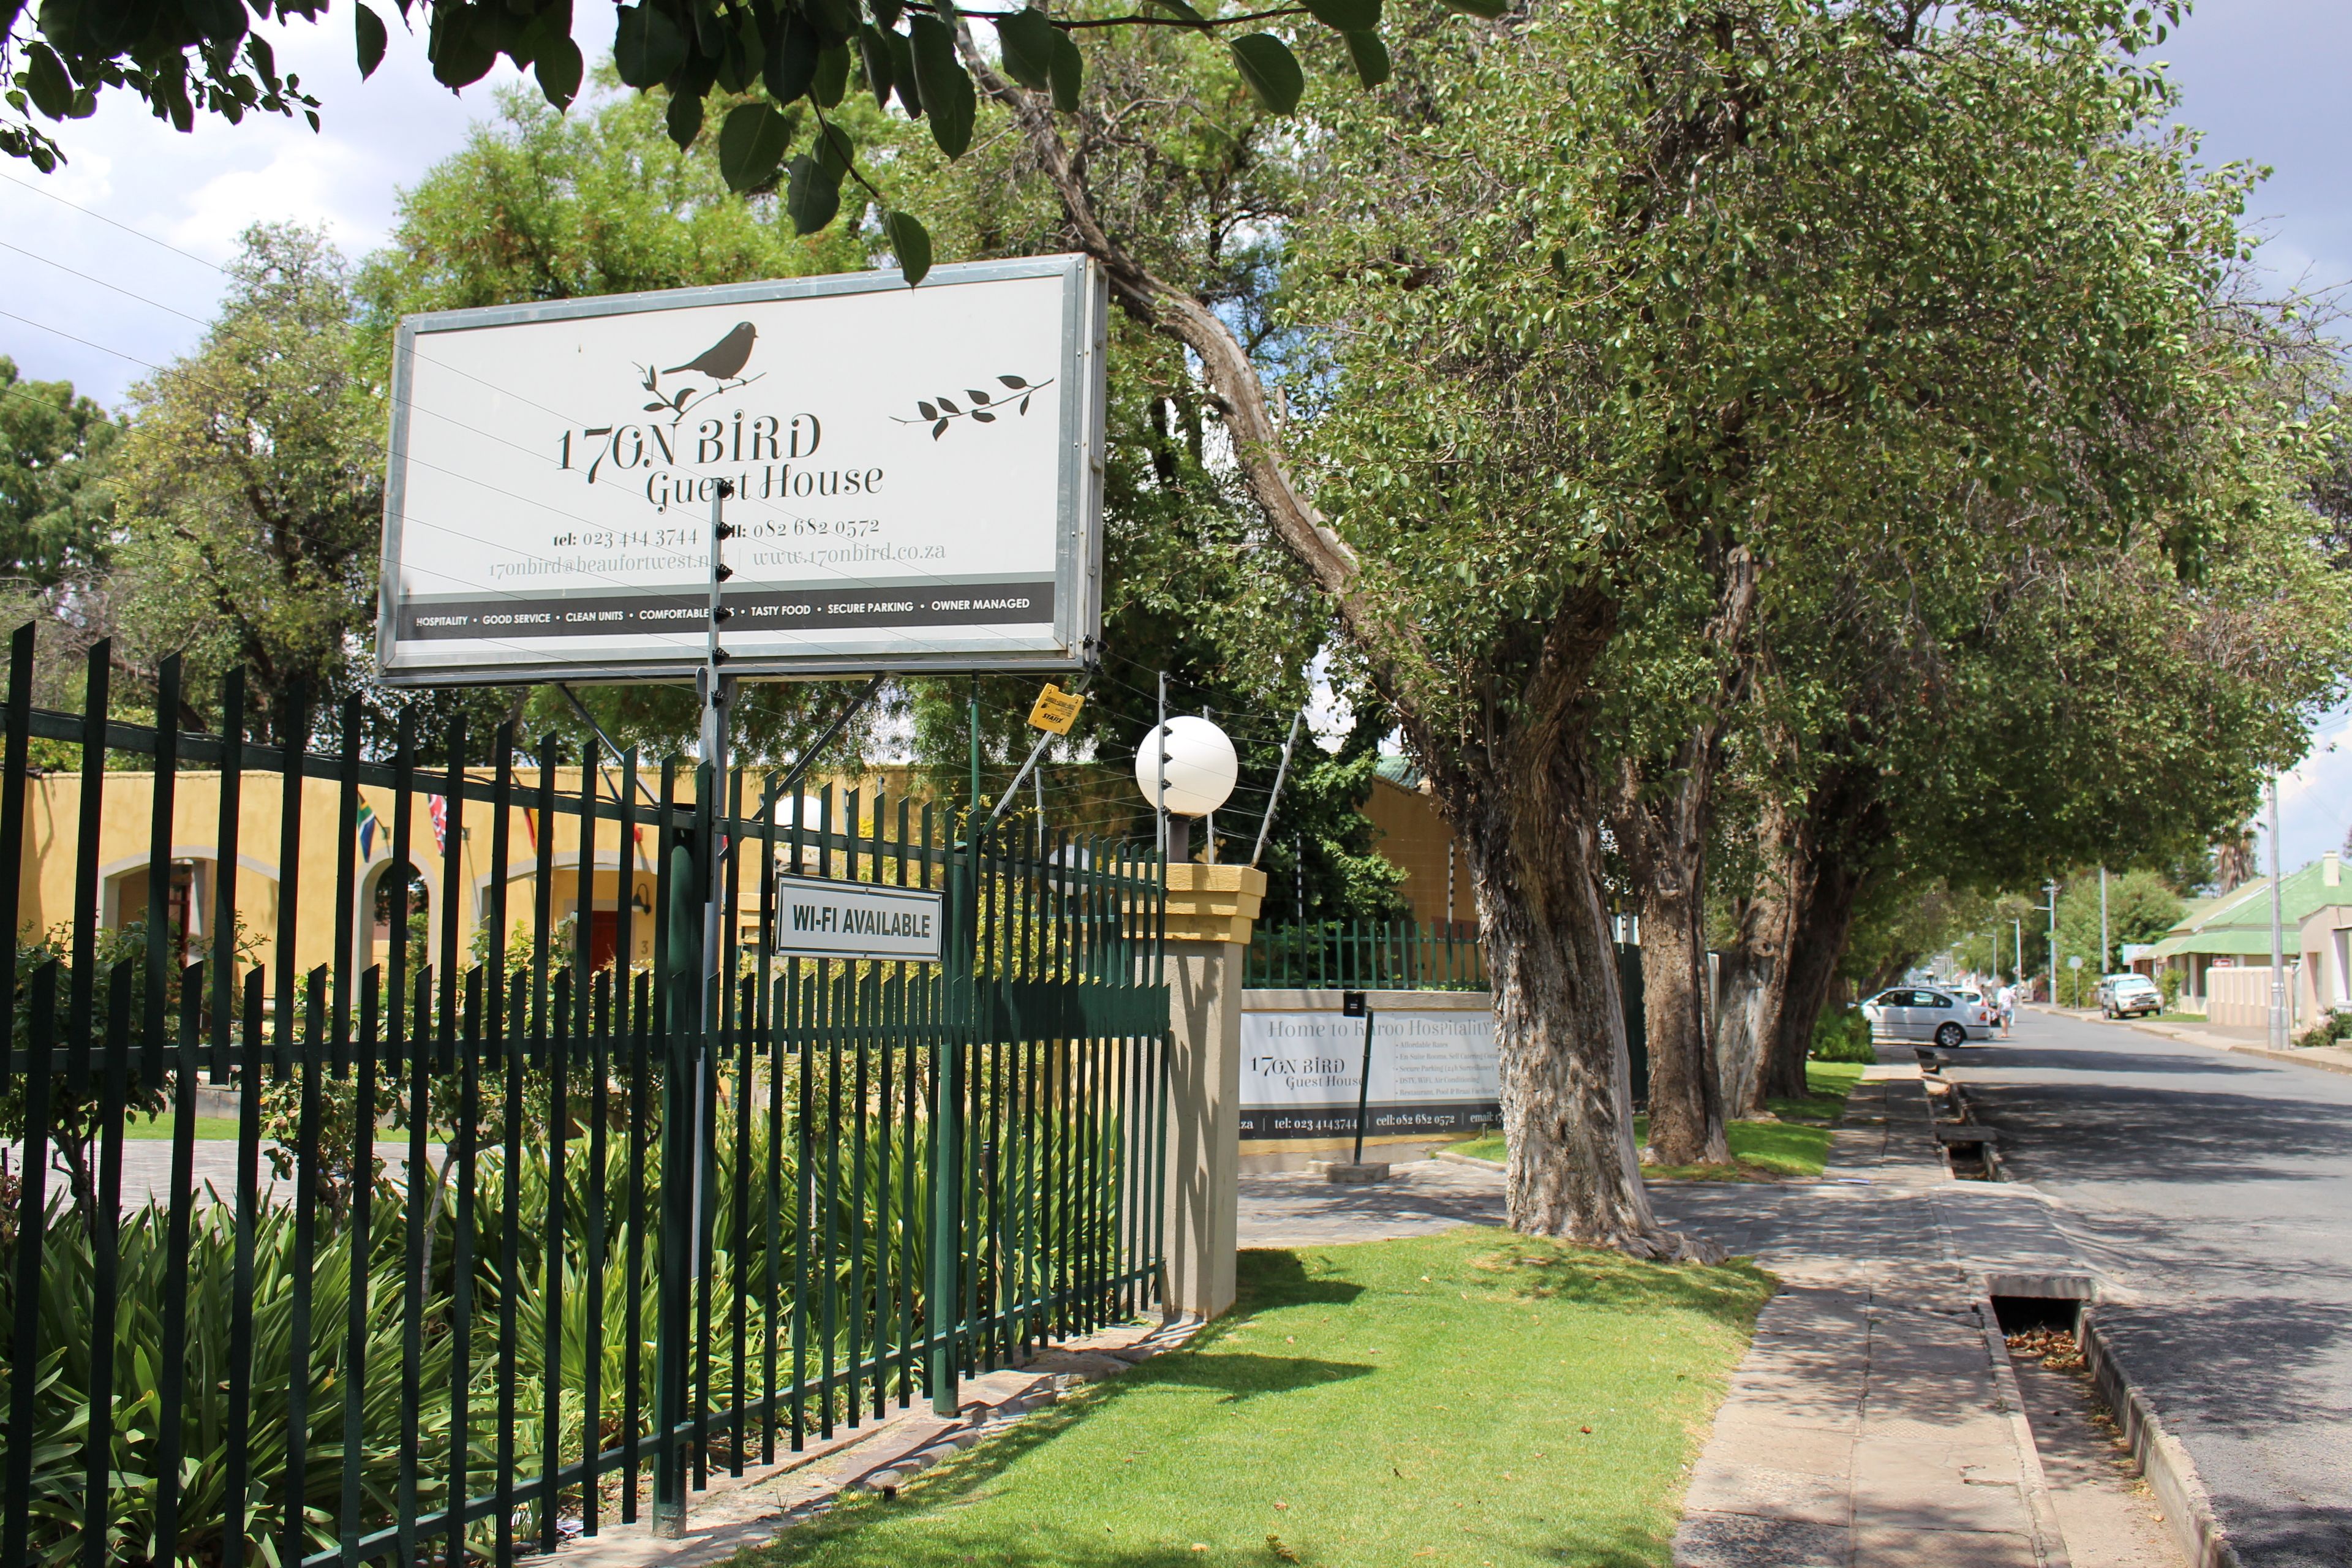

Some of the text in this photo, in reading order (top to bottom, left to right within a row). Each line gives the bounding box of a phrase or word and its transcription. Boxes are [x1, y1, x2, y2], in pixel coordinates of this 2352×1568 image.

[694, 409, 821, 464] BIRD
[759, 464, 883, 499] House
[553, 533, 577, 546] tel:
[583, 532, 613, 549] 023
[619, 529, 649, 548] 414
[655, 528, 698, 546] 3744
[753, 519, 786, 538] 082
[794, 518, 828, 537] 682
[835, 518, 880, 538] 0572
[489, 542, 946, 580] 17onbird@beaufortwest.nt www.17onbird.co.za
[416, 598, 1030, 627] HOSPITALITY GOOD SERVICE CLEAN UNITS COMFORTABLE TASTY FOOD SECURE PARKING OWNER MANAGED
[1042, 713, 1065, 723] STAFIX
[793, 905, 930, 938] WI-FI AVAILABLE
[641, 940, 649, 954] 3
[1268, 1020, 1325, 1037] Home
[1332, 1023, 1348, 1036] to
[1303, 1056, 1344, 1074] BIRD
[1286, 1076, 1322, 1090] Guest
[1275, 1117, 1291, 1129] tel:
[1294, 1120, 1313, 1131] 023
[1415, 1114, 1432, 1125] 682
[1434, 1114, 1455, 1126] 0572
[1470, 1111, 1493, 1122] email:
